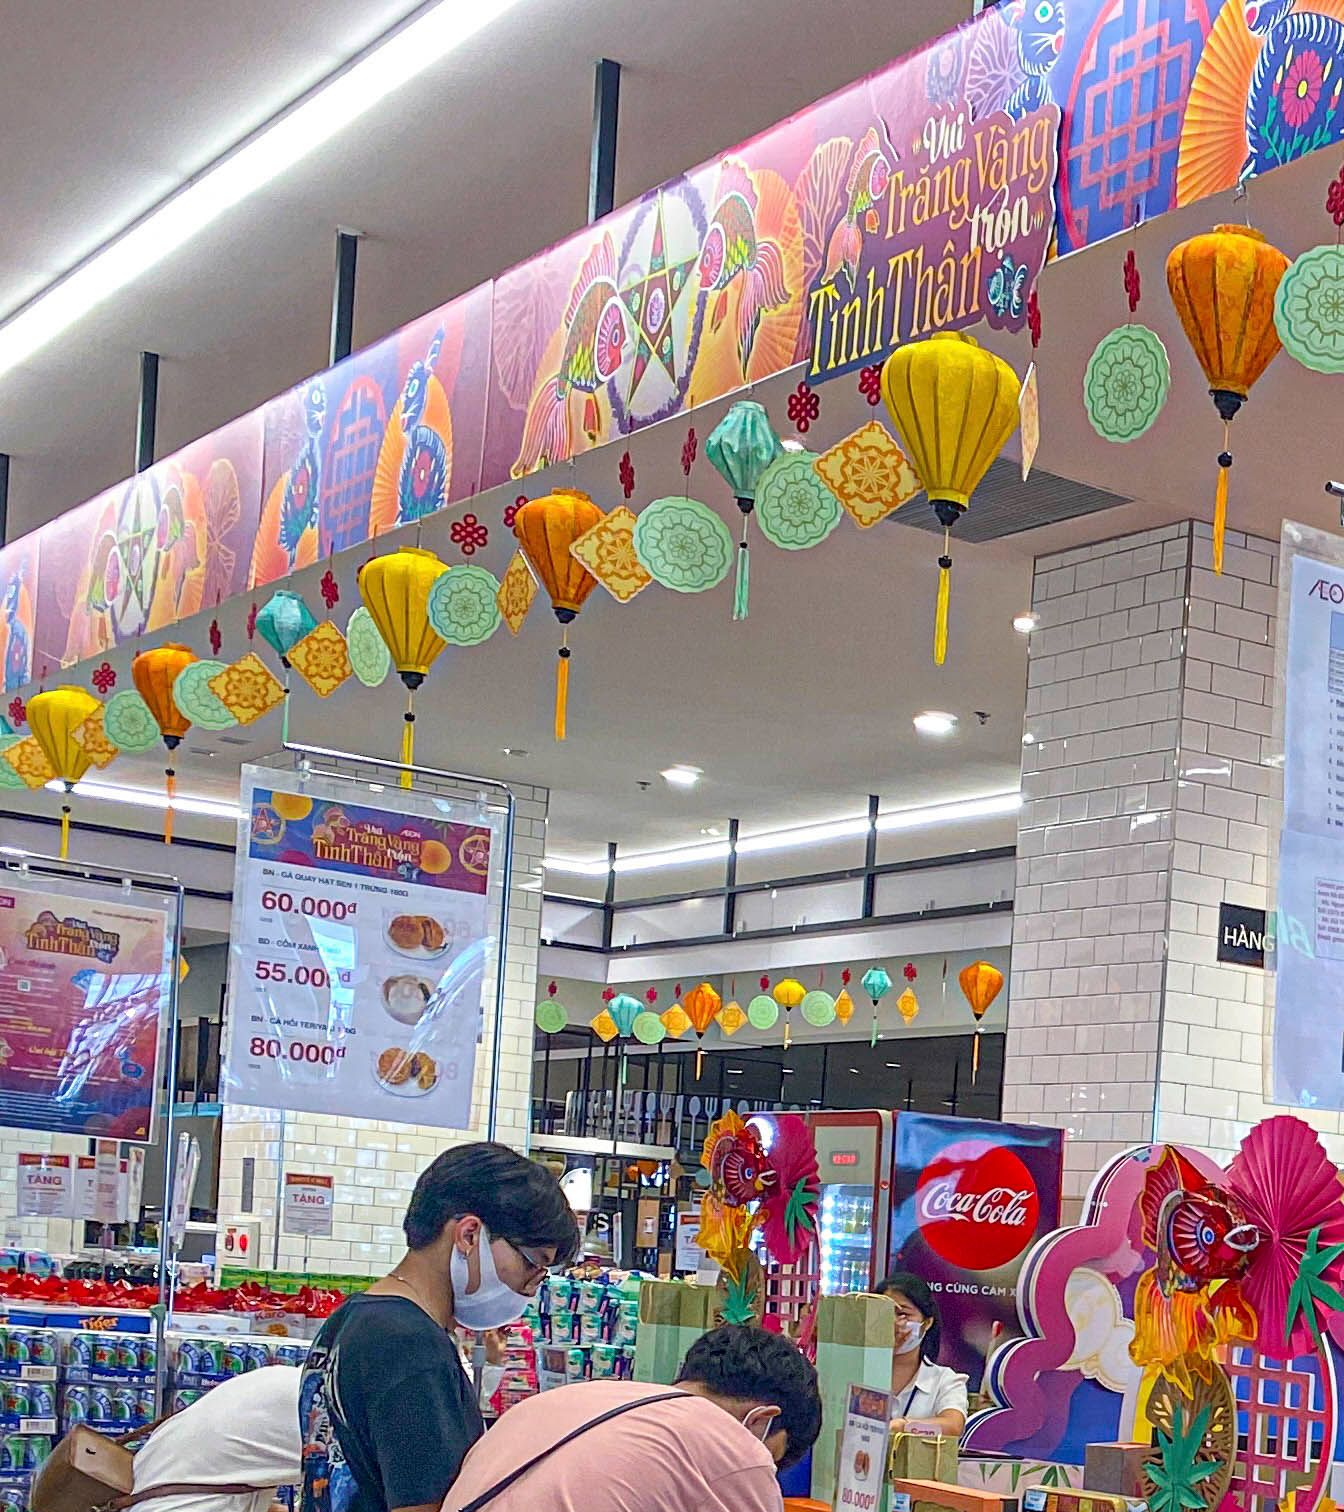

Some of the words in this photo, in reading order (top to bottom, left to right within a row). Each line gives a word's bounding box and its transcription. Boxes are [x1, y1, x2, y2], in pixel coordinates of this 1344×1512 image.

[924, 105, 965, 160] Vui
[883, 150, 972, 241] Trăng
[974, 116, 1050, 203] Vàng
[808, 272, 884, 377] Tình
[884, 243, 984, 343] Thân
[261, 890, 357, 920] 60.000đ
[249, 1036, 347, 1066] 80.000đ
[78, 1315, 119, 1331] Tiger
